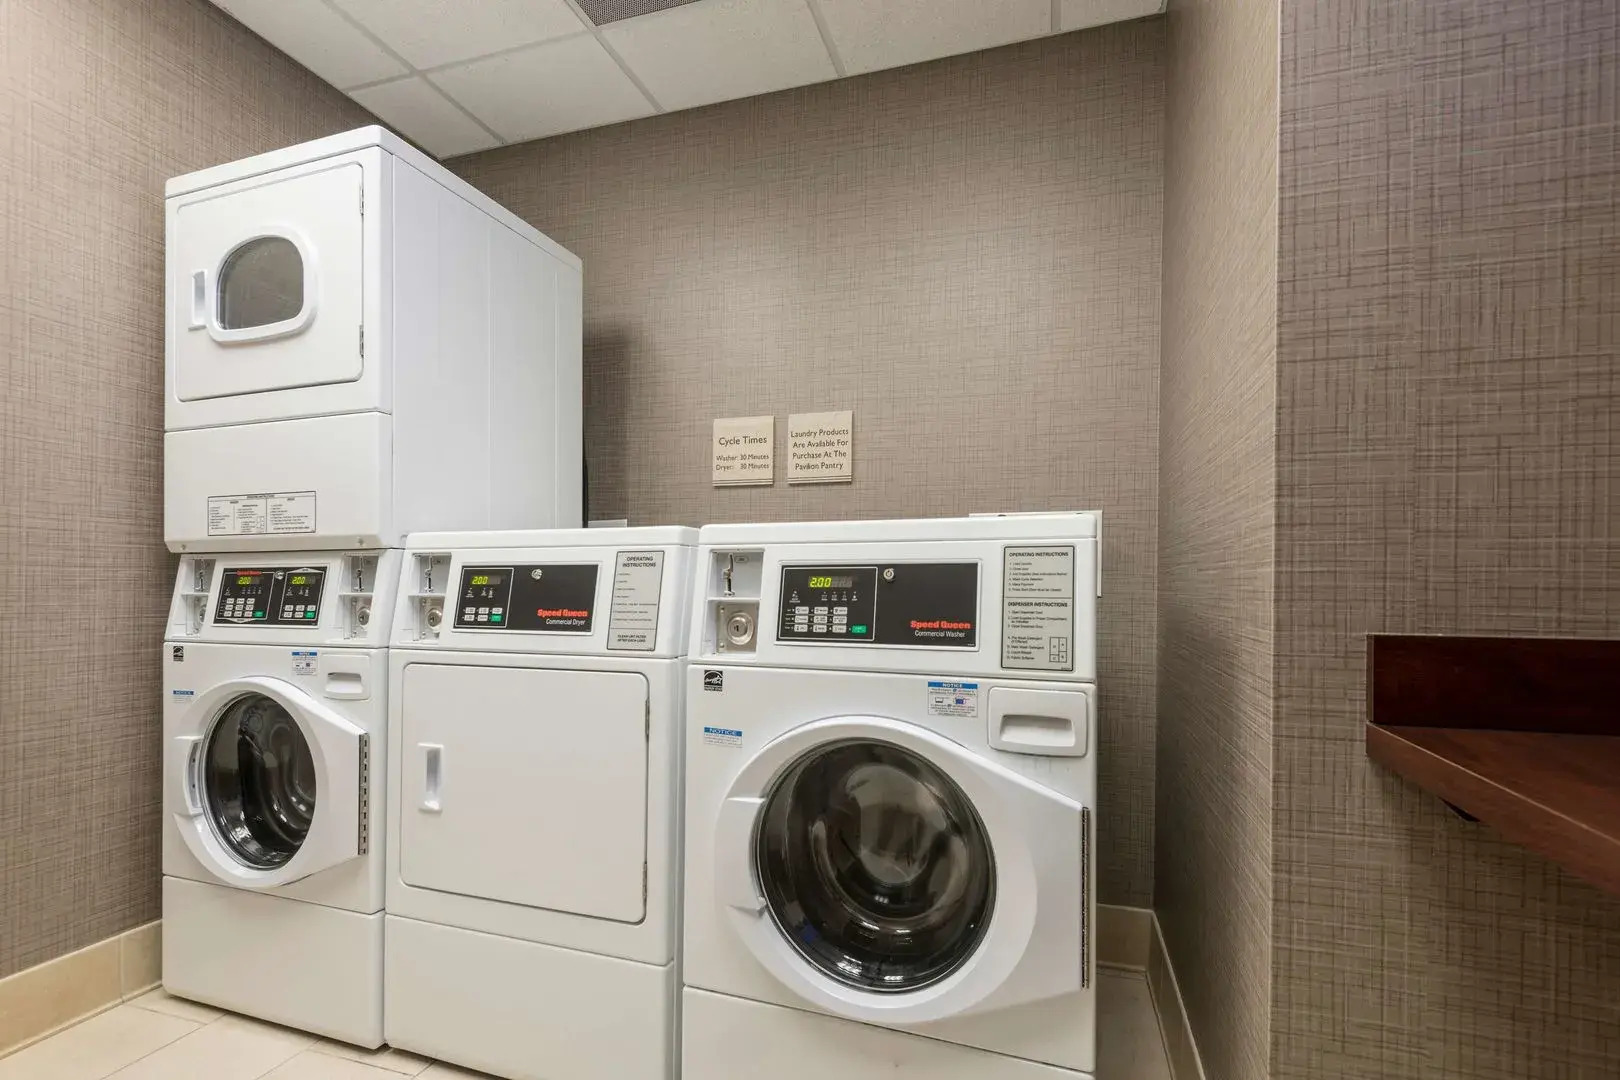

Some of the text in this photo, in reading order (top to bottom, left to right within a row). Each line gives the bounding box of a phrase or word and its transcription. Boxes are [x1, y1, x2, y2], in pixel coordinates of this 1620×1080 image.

[790, 430, 817, 438] Laundry
[718, 436, 767, 447] Cycle Times
[820, 462, 843, 470] Pantry
[810, 577, 832, 587] 2.00
[537, 609, 588, 618] Speed Queen
[911, 620, 971, 629] Speed Queen
